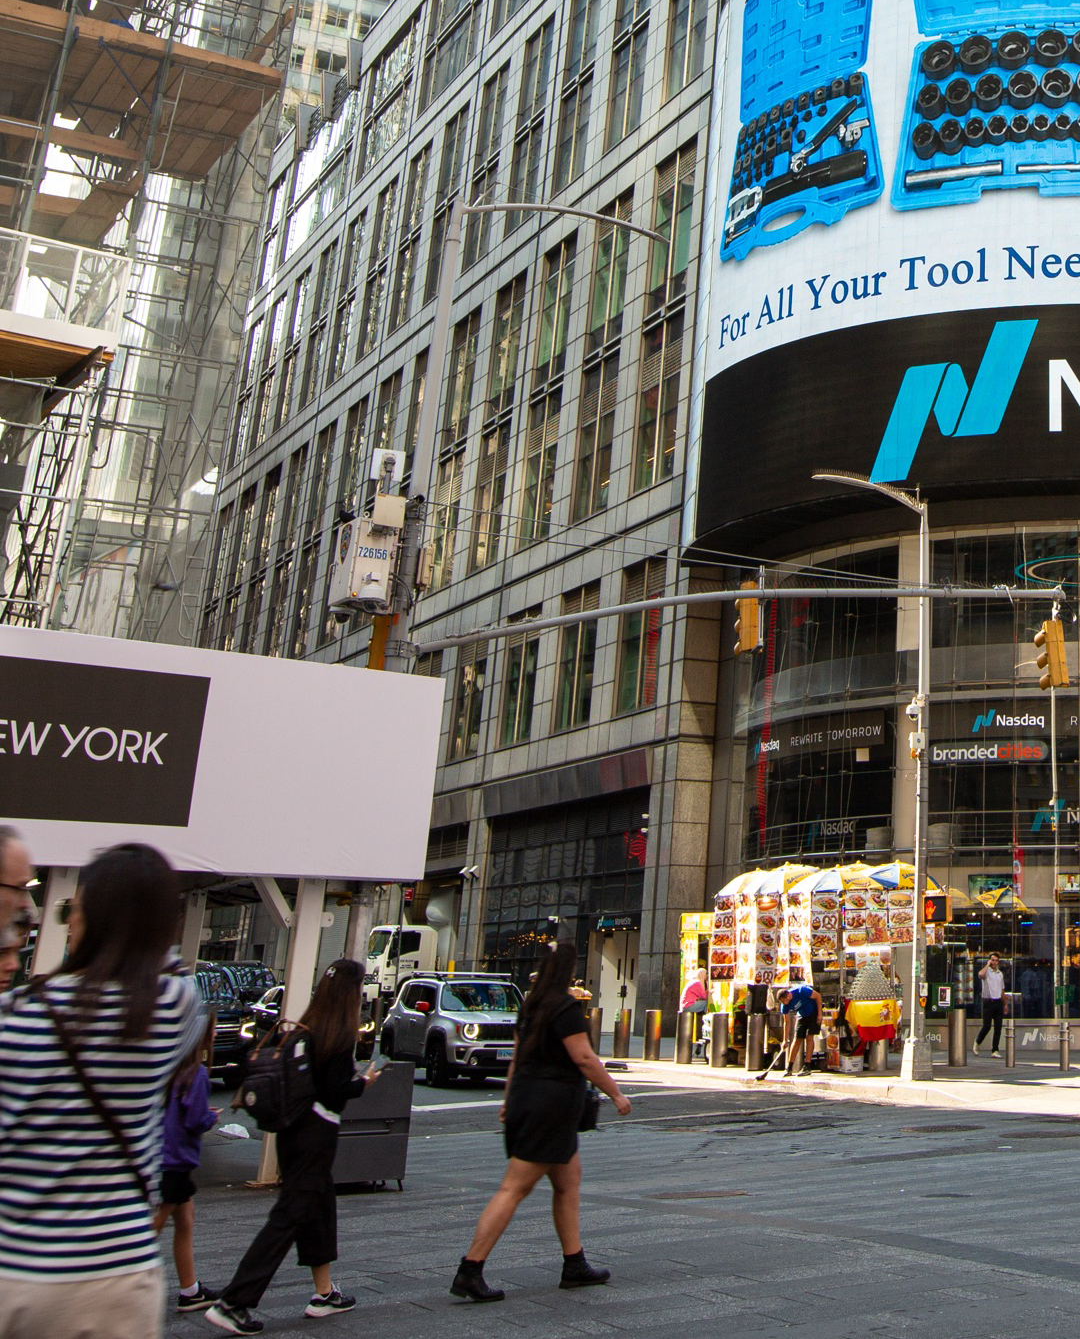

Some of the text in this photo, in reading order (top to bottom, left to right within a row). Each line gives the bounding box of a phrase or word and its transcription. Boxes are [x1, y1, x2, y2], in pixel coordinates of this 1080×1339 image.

[718, 311, 749, 349] For
[755, 286, 795, 328] All
[804, 273, 888, 309] Your
[900, 249, 990, 292] Tool
[358, 546, 388, 560] 726156
[996, 713, 1045, 728] Nasdaq
[58, 723, 169, 765] YORK
[760, 725, 882, 753] Nasdaq REWRITE TOMORROW
[932, 743, 1043, 761] brandedcities
[925, 1032, 942, 1043] daq
[1039, 1031, 1075, 1043] Nasq
